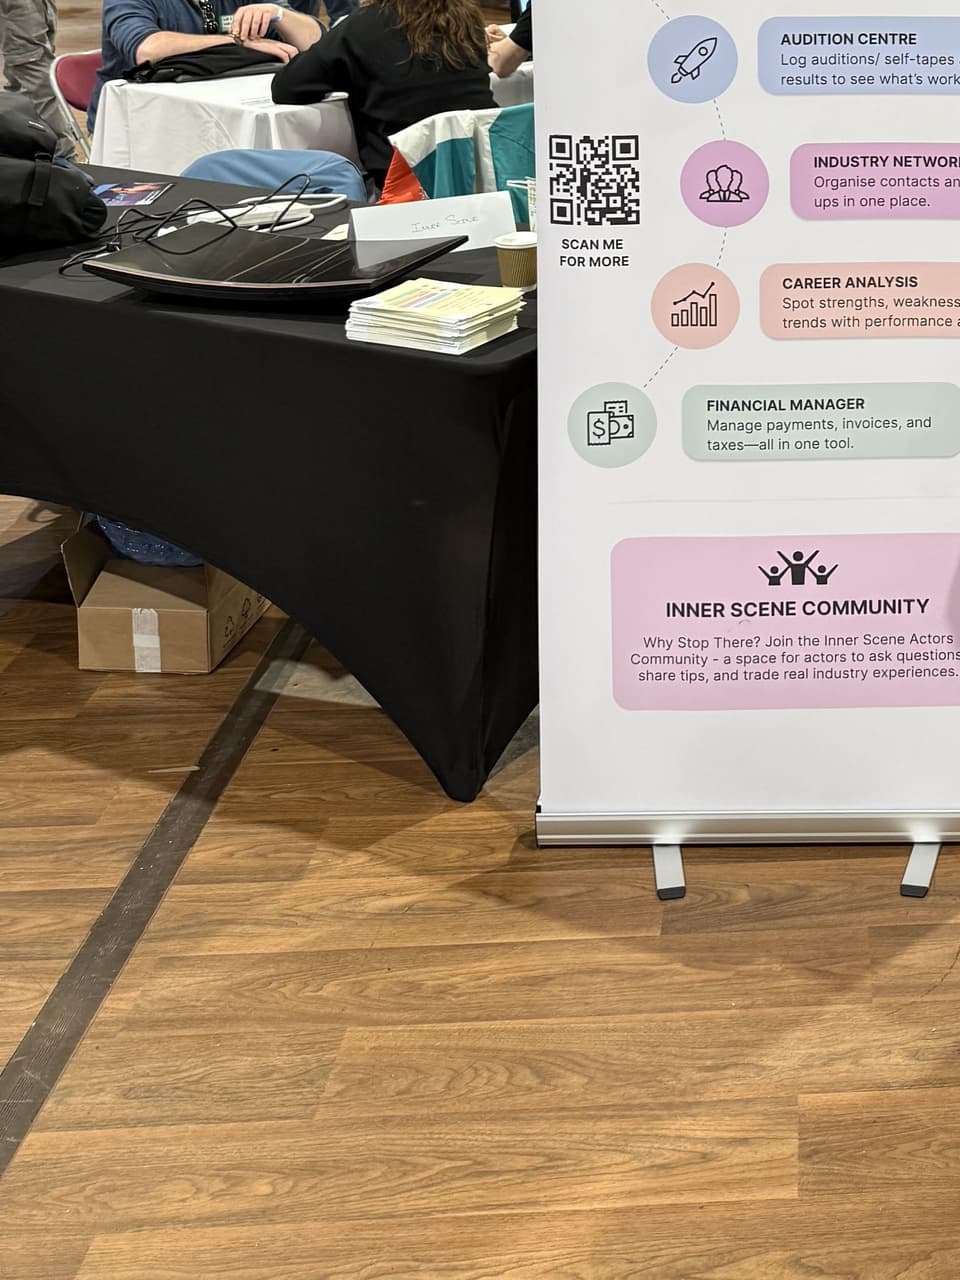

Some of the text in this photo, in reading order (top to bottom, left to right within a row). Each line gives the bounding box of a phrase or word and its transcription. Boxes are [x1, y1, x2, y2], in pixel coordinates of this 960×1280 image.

[780, 33, 917, 45] AUDITION CENTRE
[781, 53, 806, 69] Log
[811, 52, 880, 66] auditions/
[884, 52, 955, 68] self-tapes
[781, 73, 828, 85] results
[831, 74, 846, 85] to
[850, 75, 875, 85] see
[814, 155, 889, 168] INDUSTRY
[814, 175, 876, 191] Organise
[880, 176, 940, 188] contacts
[814, 195, 930, 210] ups in one place.
[561, 238, 623, 250] SCAN ME
[560, 255, 629, 267] FOR MORE
[782, 276, 918, 290] CAREER ANALYSIS
[782, 297, 814, 312] Spot
[819, 296, 888, 311] strengths,
[782, 316, 827, 329] trends
[831, 315, 860, 328] with
[865, 314, 953, 330] performance
[707, 398, 865, 412] FINANCIAL MANAGER
[707, 416, 931, 434] Manage payments, invoices, and
[778, 438, 790, 450] in
[794, 440, 820, 450] one
[824, 437, 854, 449] tool.
[666, 598, 930, 618] INNER SCENE COMMUNITY
[643, 633, 954, 651] Why Stop There? Join the Inner Scene Actors
[630, 653, 708, 668] Community
[723, 655, 731, 665] a
[736, 654, 777, 667] space
[781, 651, 800, 663] for
[804, 652, 847, 663] actors
[851, 652, 865, 663] to
[869, 650, 892, 662] ask
[638, 665, 959, 684] share tips, and trade real industry experiences.
